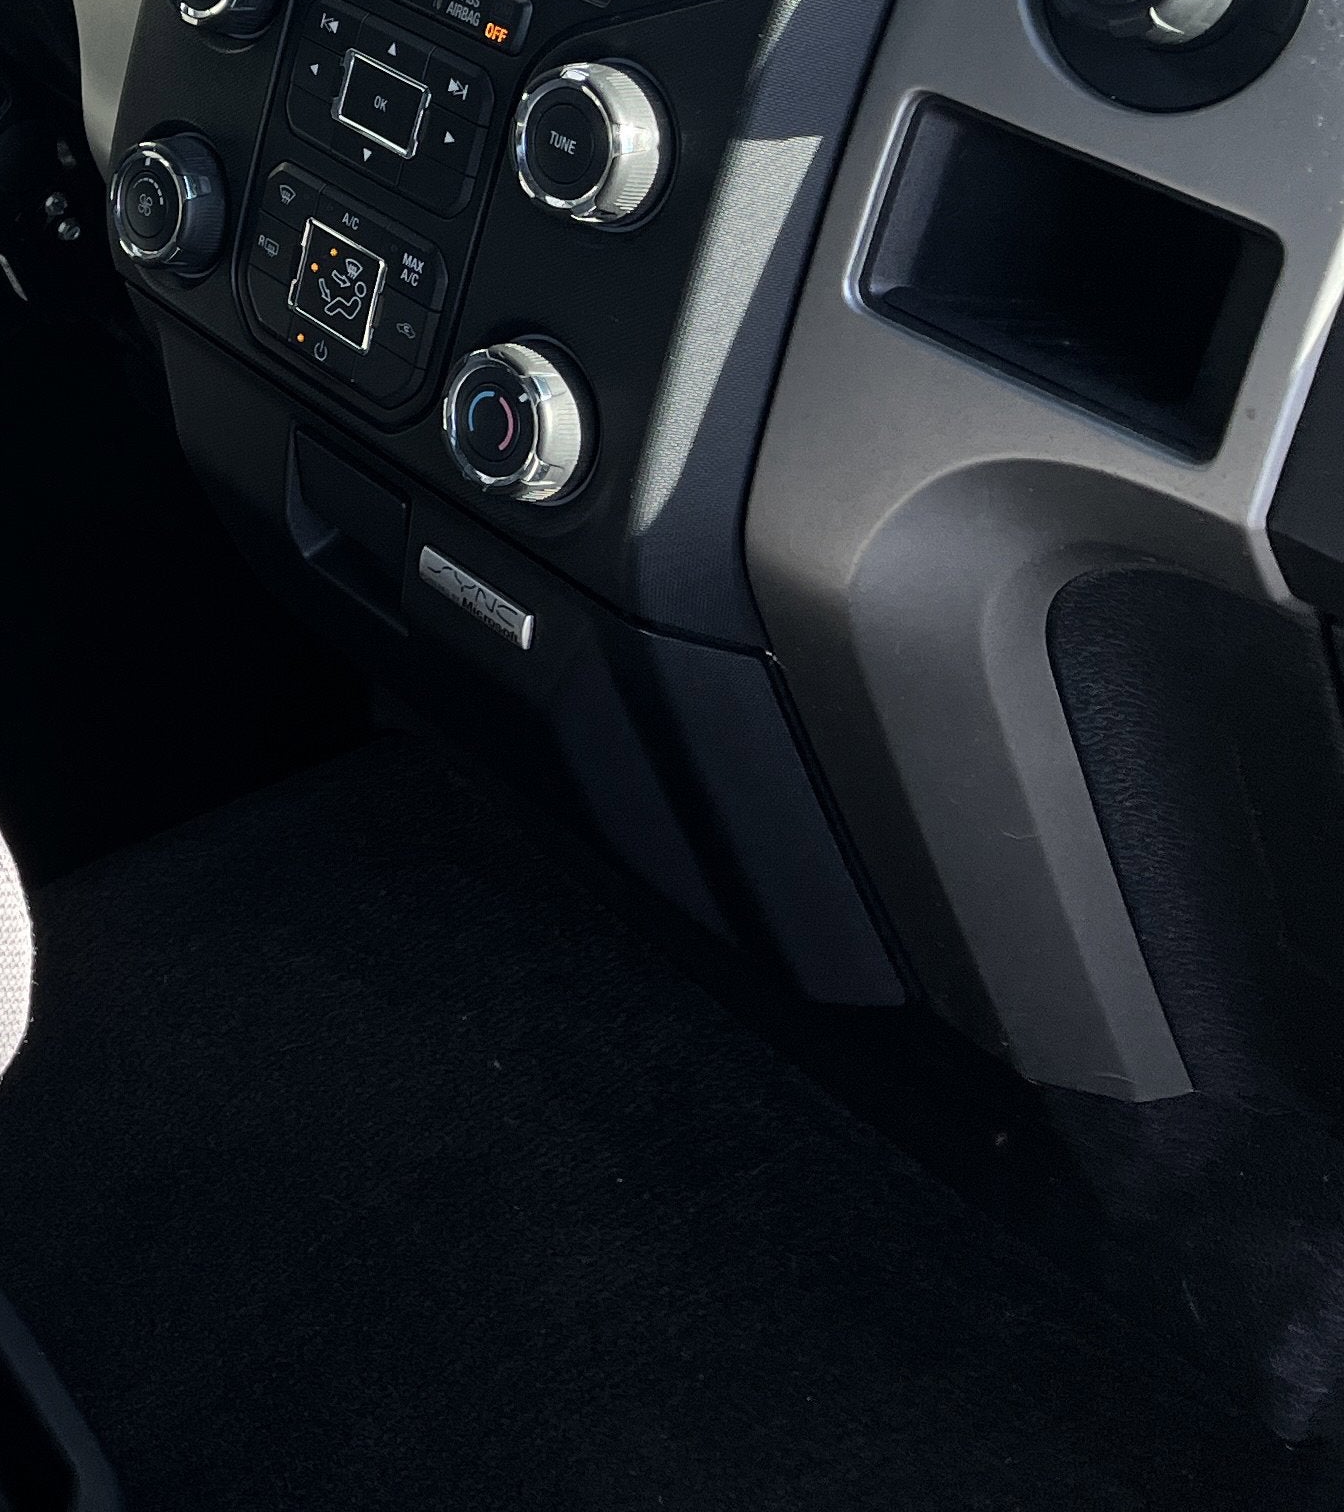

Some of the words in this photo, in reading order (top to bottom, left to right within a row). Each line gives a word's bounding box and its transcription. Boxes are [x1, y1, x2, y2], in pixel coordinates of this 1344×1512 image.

[445, 0, 481, 27] AIRBAG
[484, 22, 509, 43] OFF
[373, 95, 388, 112] OK
[548, 130, 577, 155] TUNE
[341, 212, 360, 231] A/C
[401, 252, 425, 275] MAX
[400, 268, 420, 287] A/C
